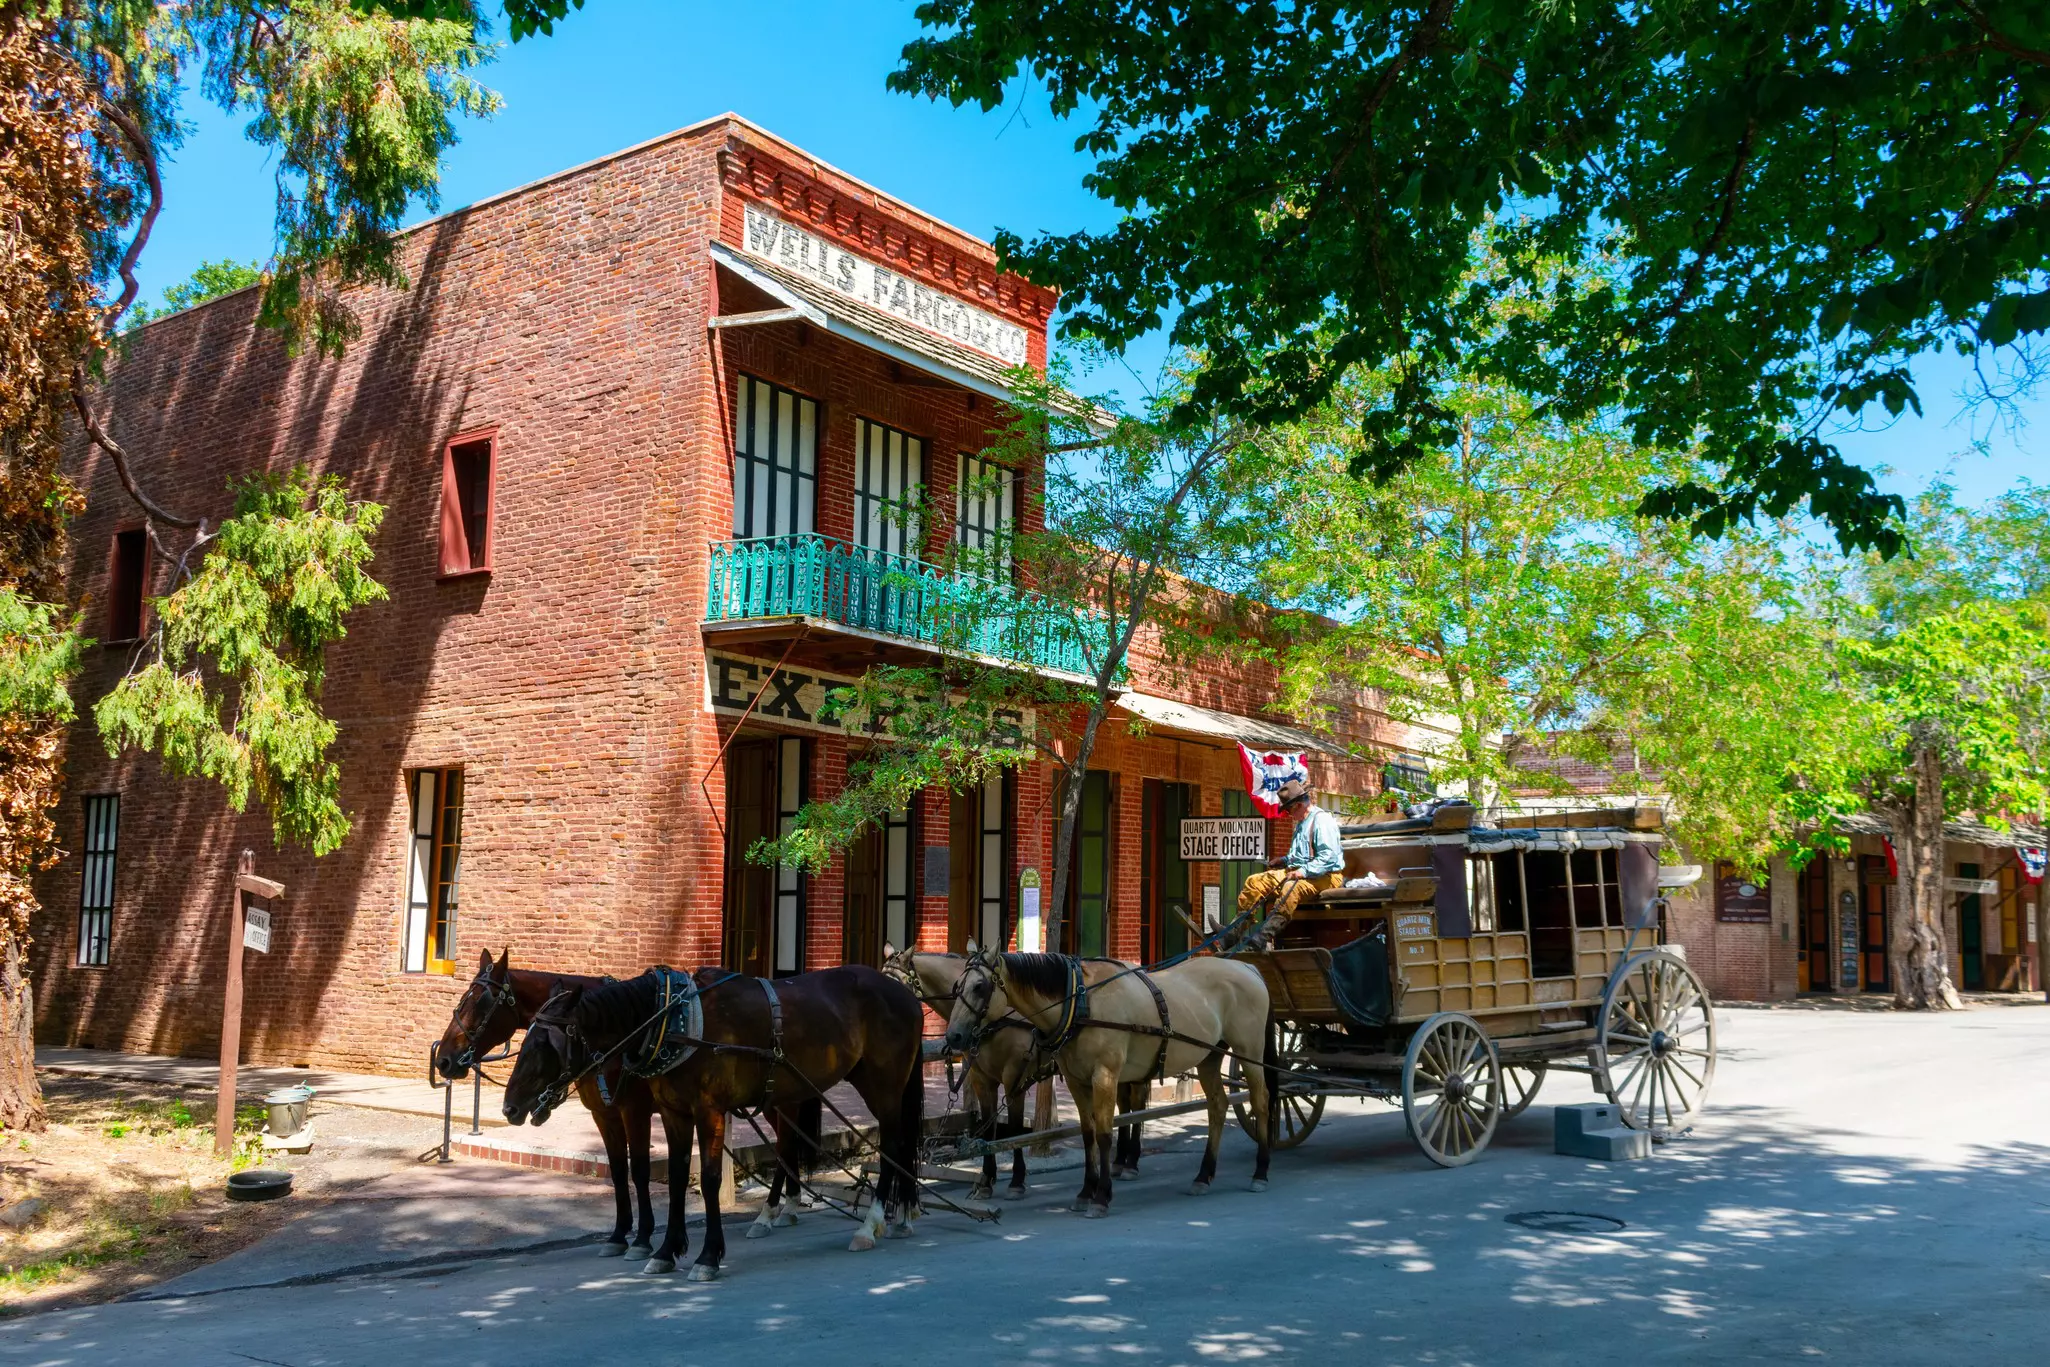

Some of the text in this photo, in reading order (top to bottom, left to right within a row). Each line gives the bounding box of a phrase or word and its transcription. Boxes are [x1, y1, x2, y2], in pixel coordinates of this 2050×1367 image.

[873, 267, 971, 342] FARGO
[1183, 820, 1263, 834] QUARTZ MOUNTAIN
[1183, 836, 1264, 856] STAGE OFFICE.
[247, 912, 266, 929] ASSAY
[1396, 915, 1417, 928] QUARTZ
[252, 930, 267, 946] OFFICE
[1399, 926, 1431, 936] STAGE LINE
